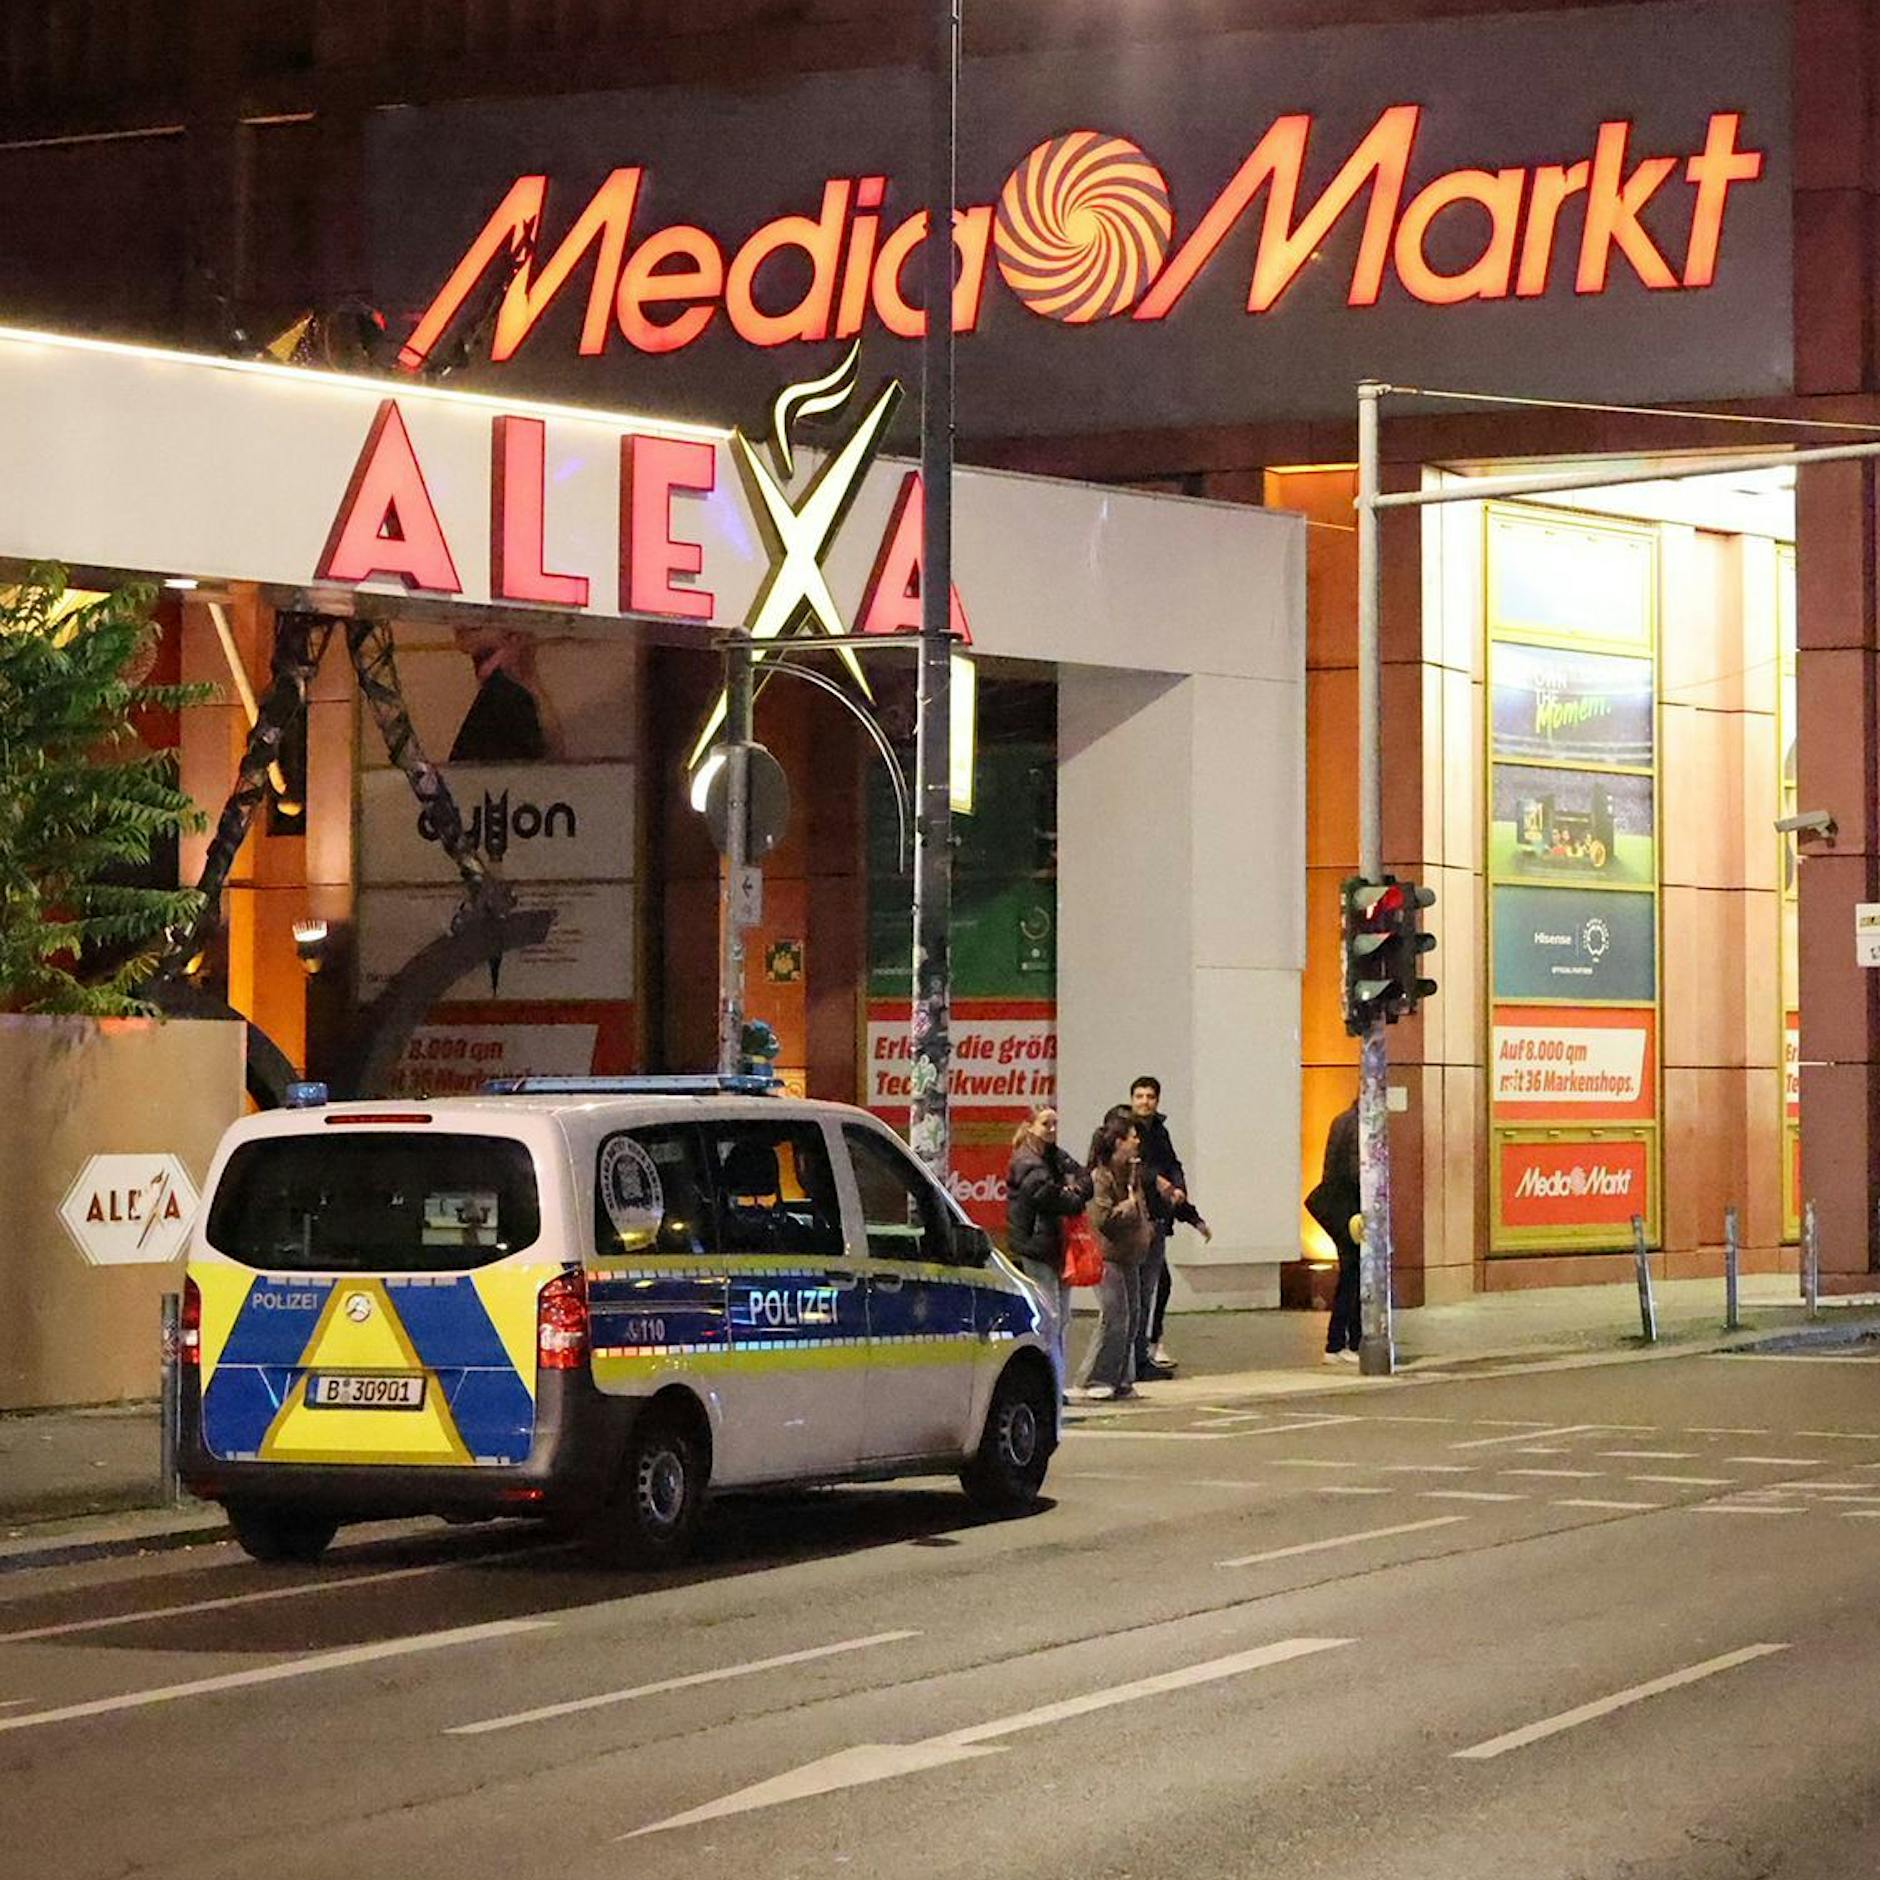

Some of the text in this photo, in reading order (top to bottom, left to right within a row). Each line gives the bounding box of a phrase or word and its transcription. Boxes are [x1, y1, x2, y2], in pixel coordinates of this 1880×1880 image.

[397, 103, 1763, 370] Media Markt
[314, 372, 972, 768] ALEXA
[1534, 931, 1572, 946] Hisense
[956, 1035, 994, 1060] die
[1499, 1040, 1588, 1064] Auf 8.000 qm
[876, 1069, 1026, 1096] Tecikwelt
[1500, 1069, 1635, 1096] mit 36 Markenshops.
[1515, 1165, 1633, 1198] Media Markt
[251, 1292, 318, 1310] POLIZEI
[749, 1288, 839, 1326] POLIZEI
[640, 1318, 666, 1342] 110
[326, 1380, 411, 1403] B 30901
